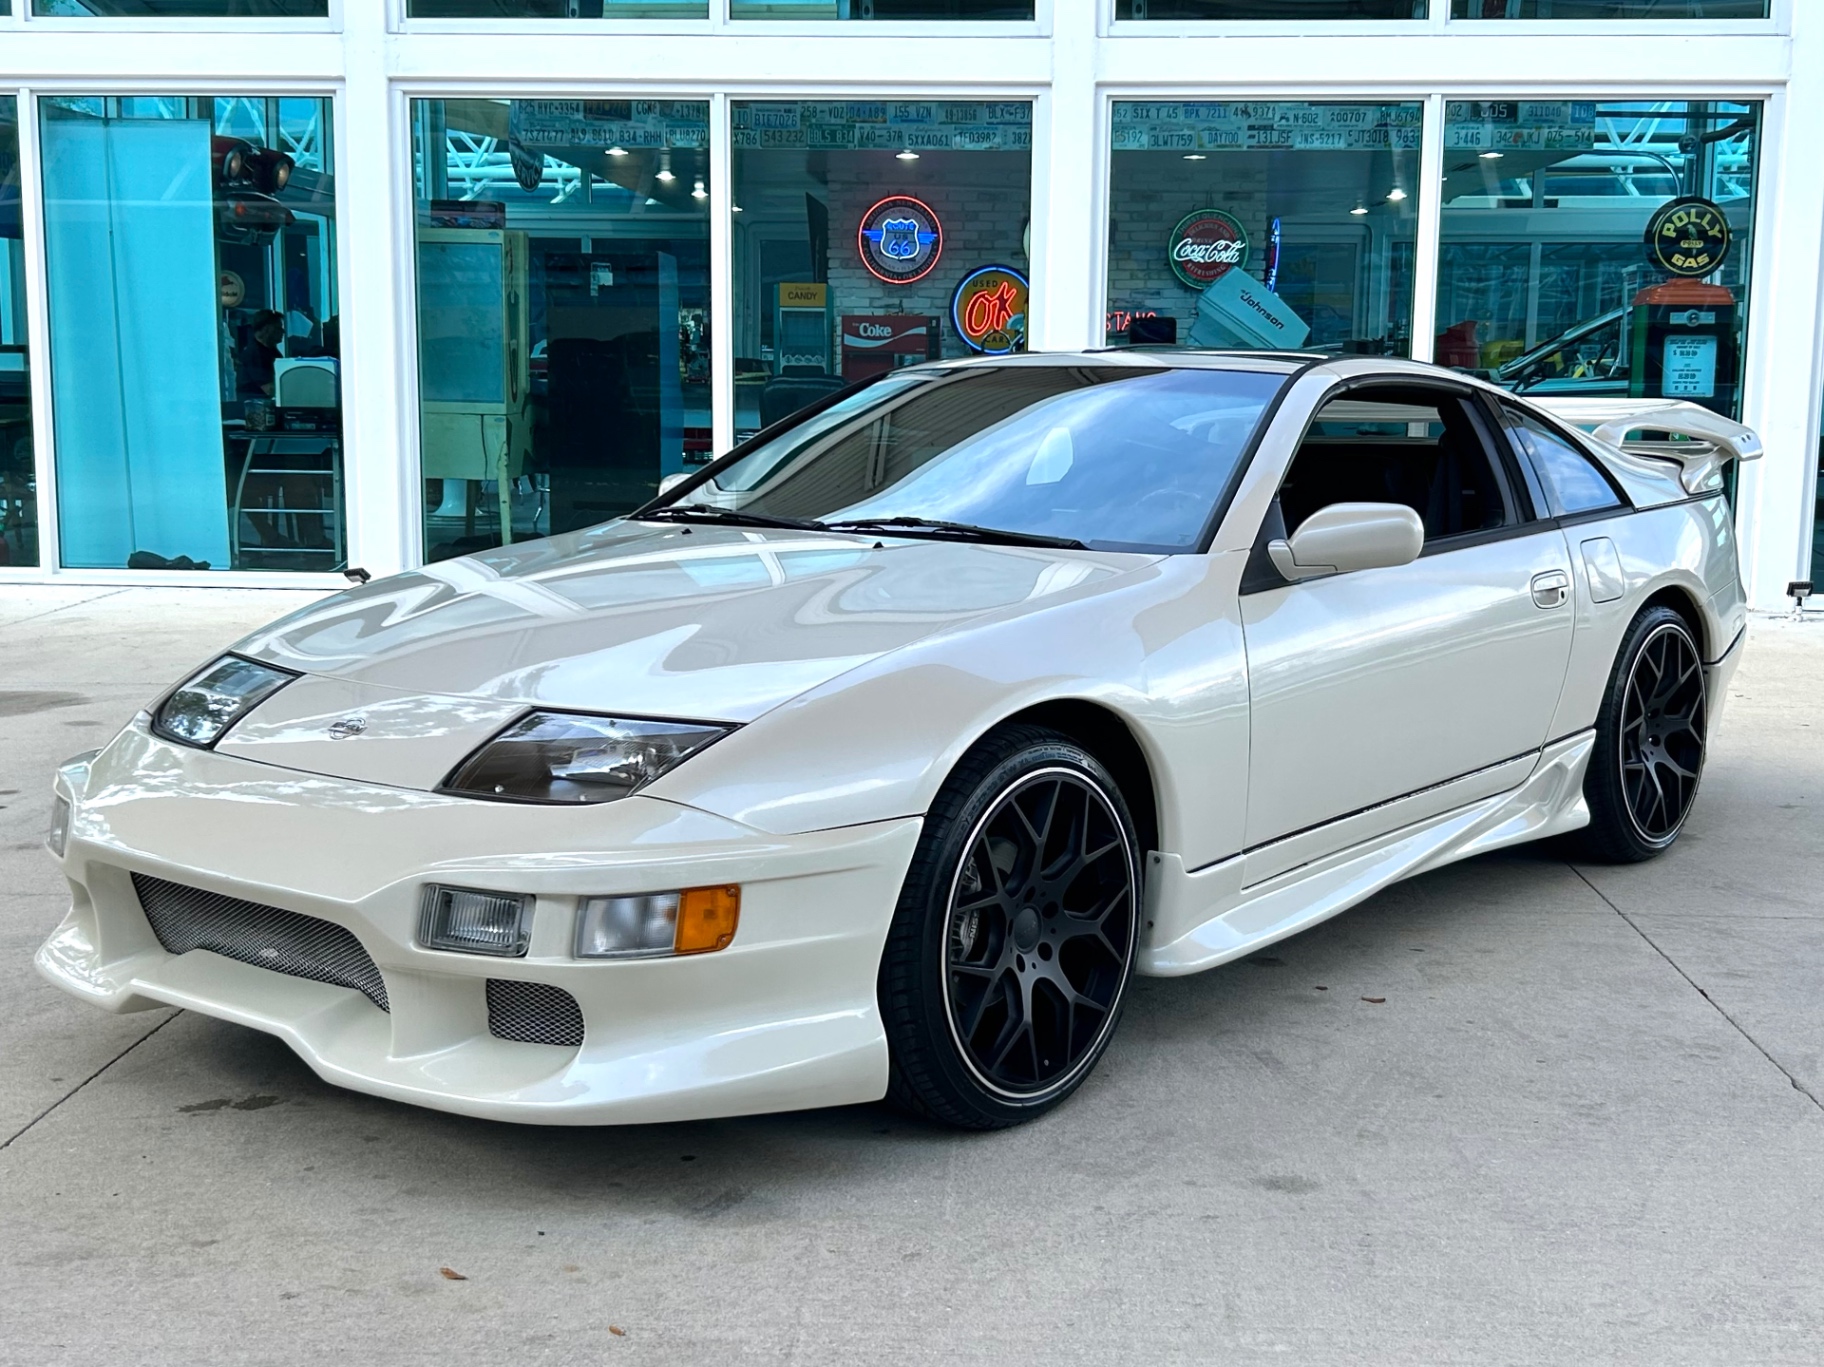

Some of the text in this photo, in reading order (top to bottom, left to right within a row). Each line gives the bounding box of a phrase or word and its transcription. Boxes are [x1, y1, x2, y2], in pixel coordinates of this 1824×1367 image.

[1133, 108, 1151, 119] SIX
[1155, 108, 1162, 119] T
[1662, 208, 1722, 238] POLLY
[888, 240, 911, 256] 66
[1174, 237, 1246, 263] Coca-Cola
[1671, 253, 1710, 268] GAS
[973, 280, 998, 288] USED
[788, 291, 817, 300] CANDY
[965, 281, 1018, 337] OK
[1240, 291, 1285, 330] Johnson
[859, 322, 893, 337] Coke
